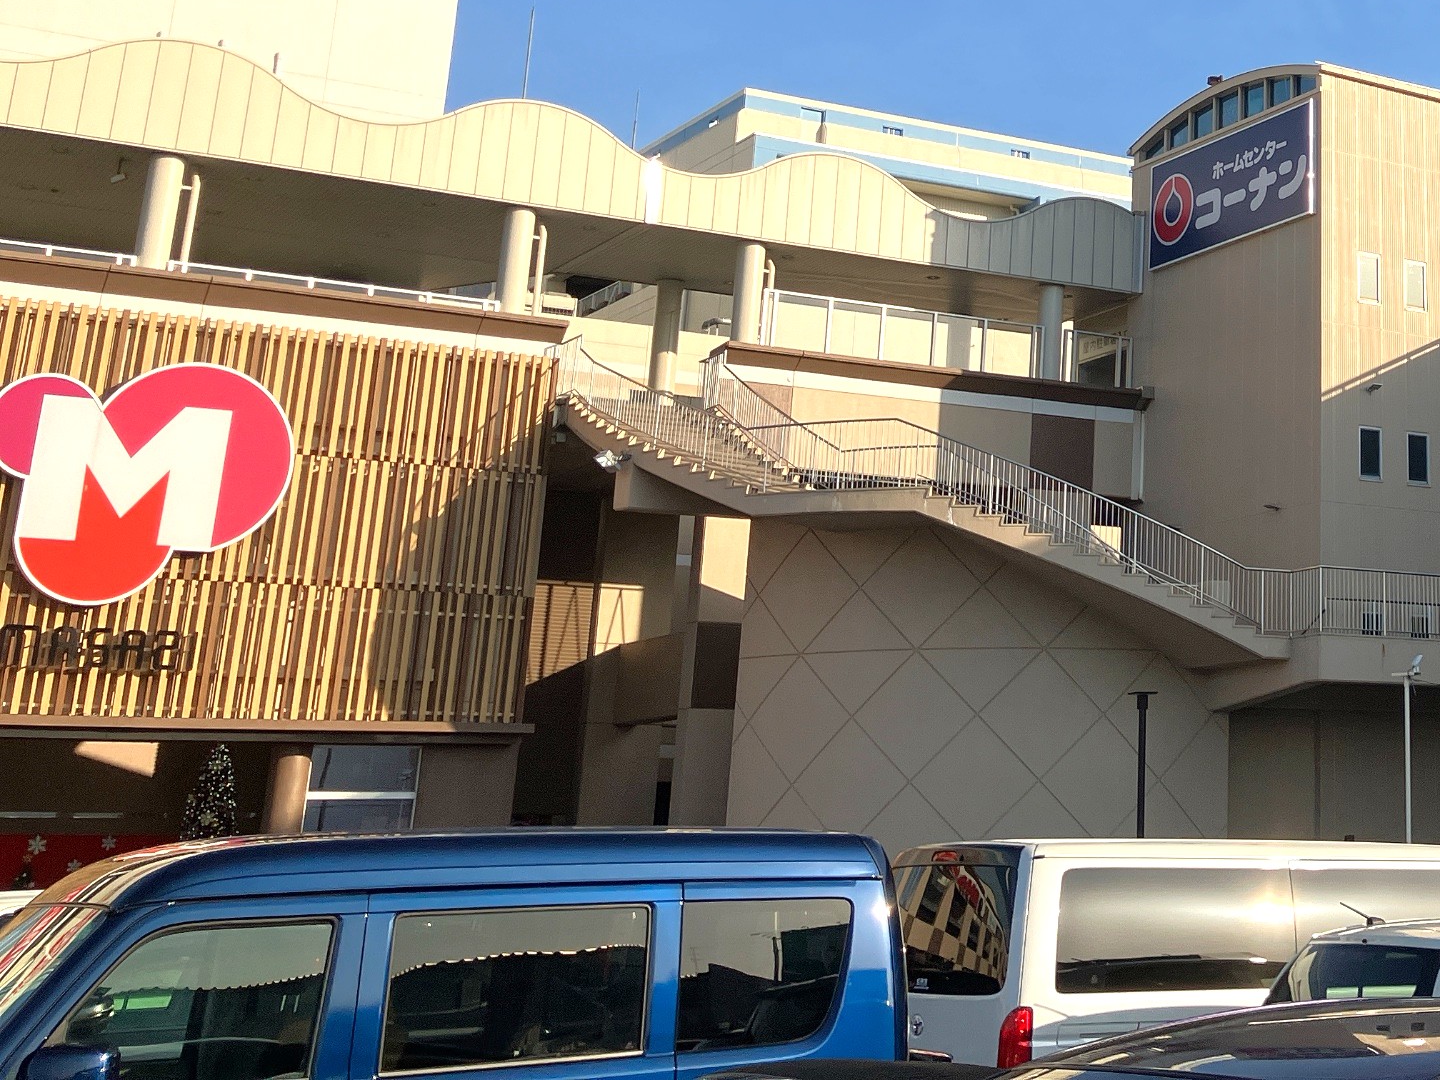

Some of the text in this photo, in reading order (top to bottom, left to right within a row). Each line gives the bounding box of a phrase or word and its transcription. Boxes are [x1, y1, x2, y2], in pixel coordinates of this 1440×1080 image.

[1195, 154, 1307, 230] コーナン
[1212, 140, 1288, 180] ホームセンター
[19, 393, 233, 552] M
